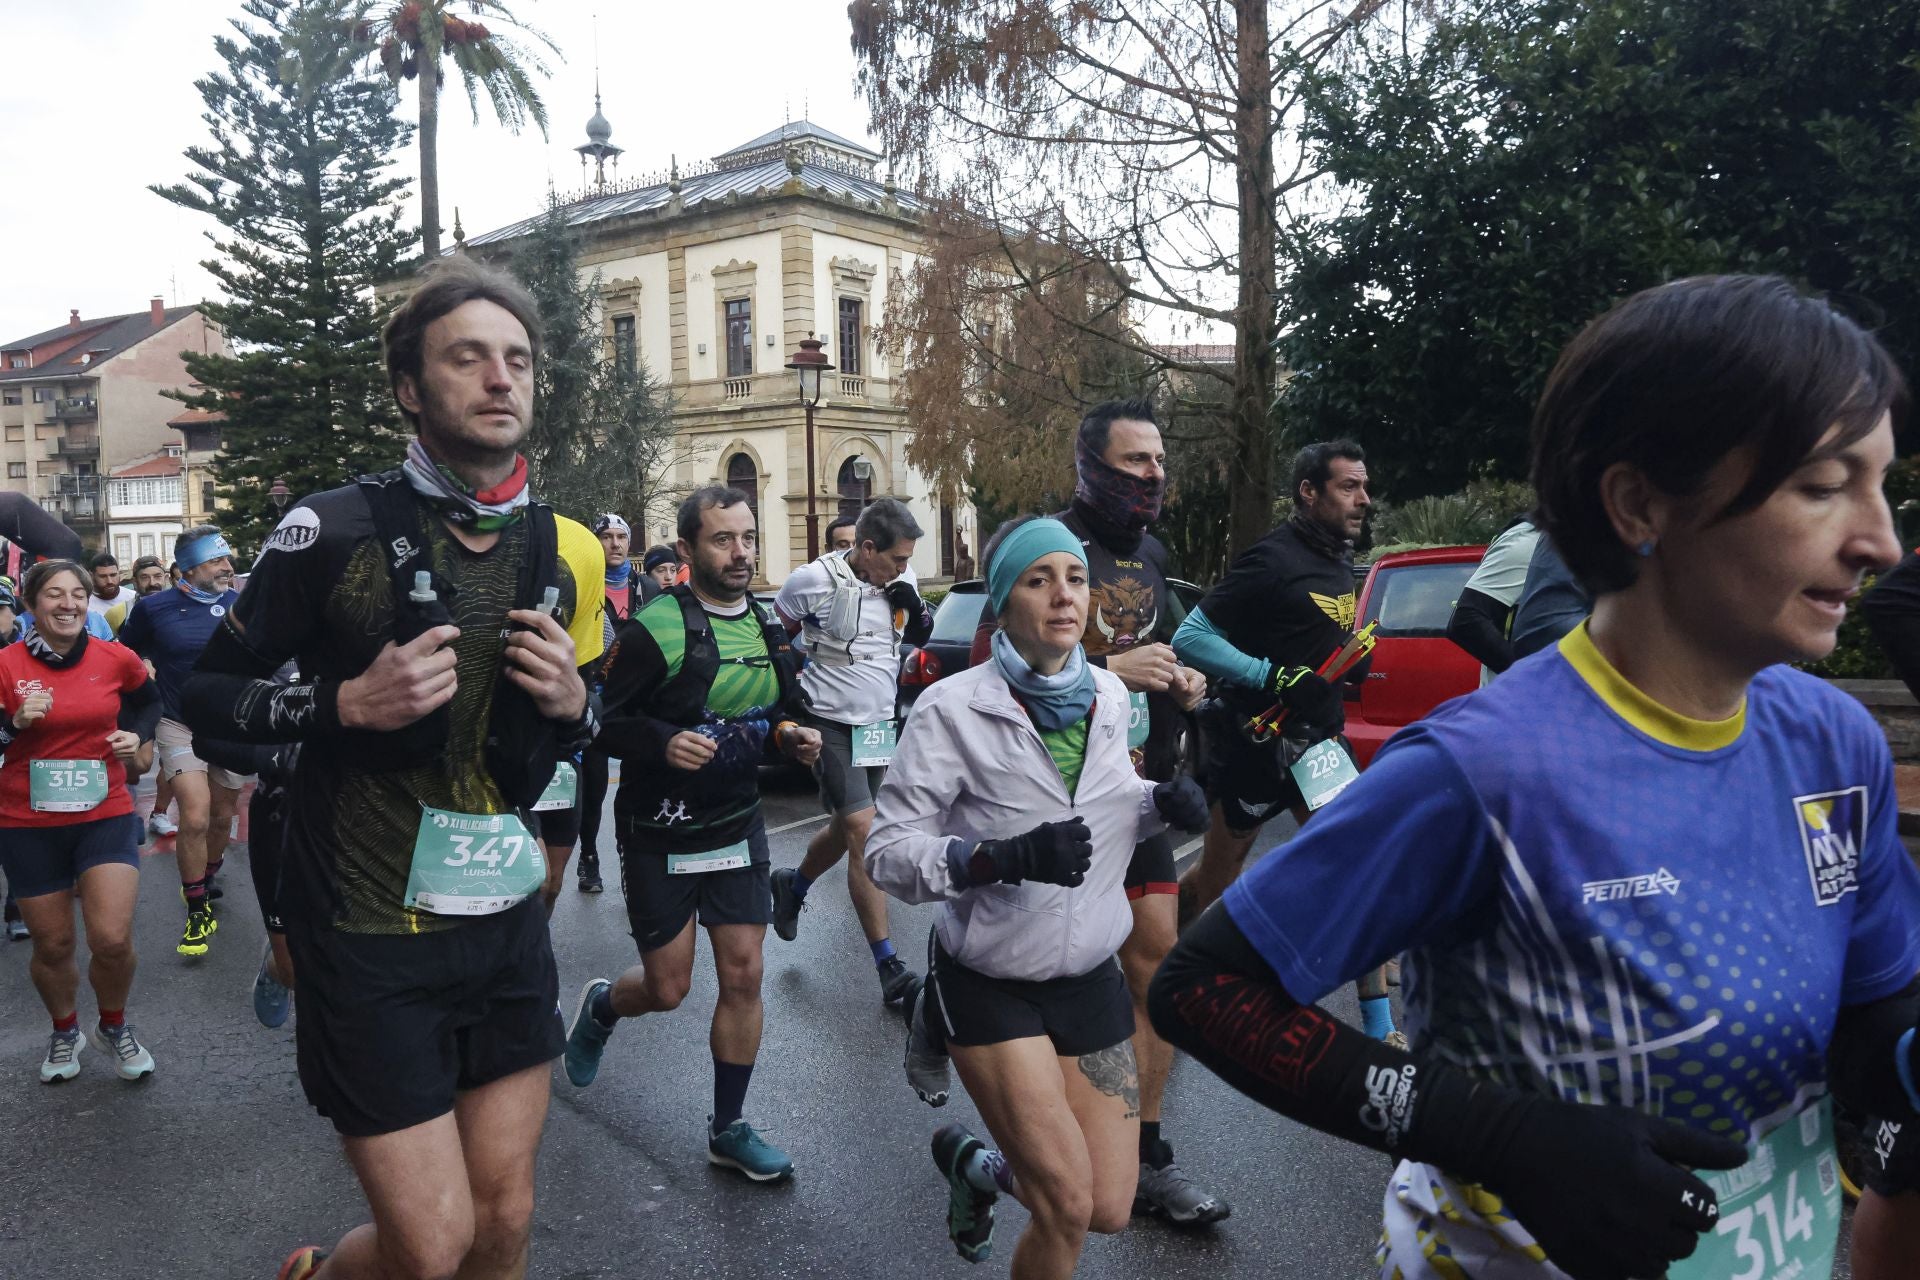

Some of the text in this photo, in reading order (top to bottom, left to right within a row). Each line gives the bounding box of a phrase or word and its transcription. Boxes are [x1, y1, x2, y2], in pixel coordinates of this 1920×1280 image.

[863, 730, 885, 745] 251
[1306, 750, 1340, 779] 228
[48, 770, 89, 787] 315
[443, 834, 524, 868] 347
[463, 868, 502, 877] LUISMA
[1715, 1169, 1814, 1280] 314
